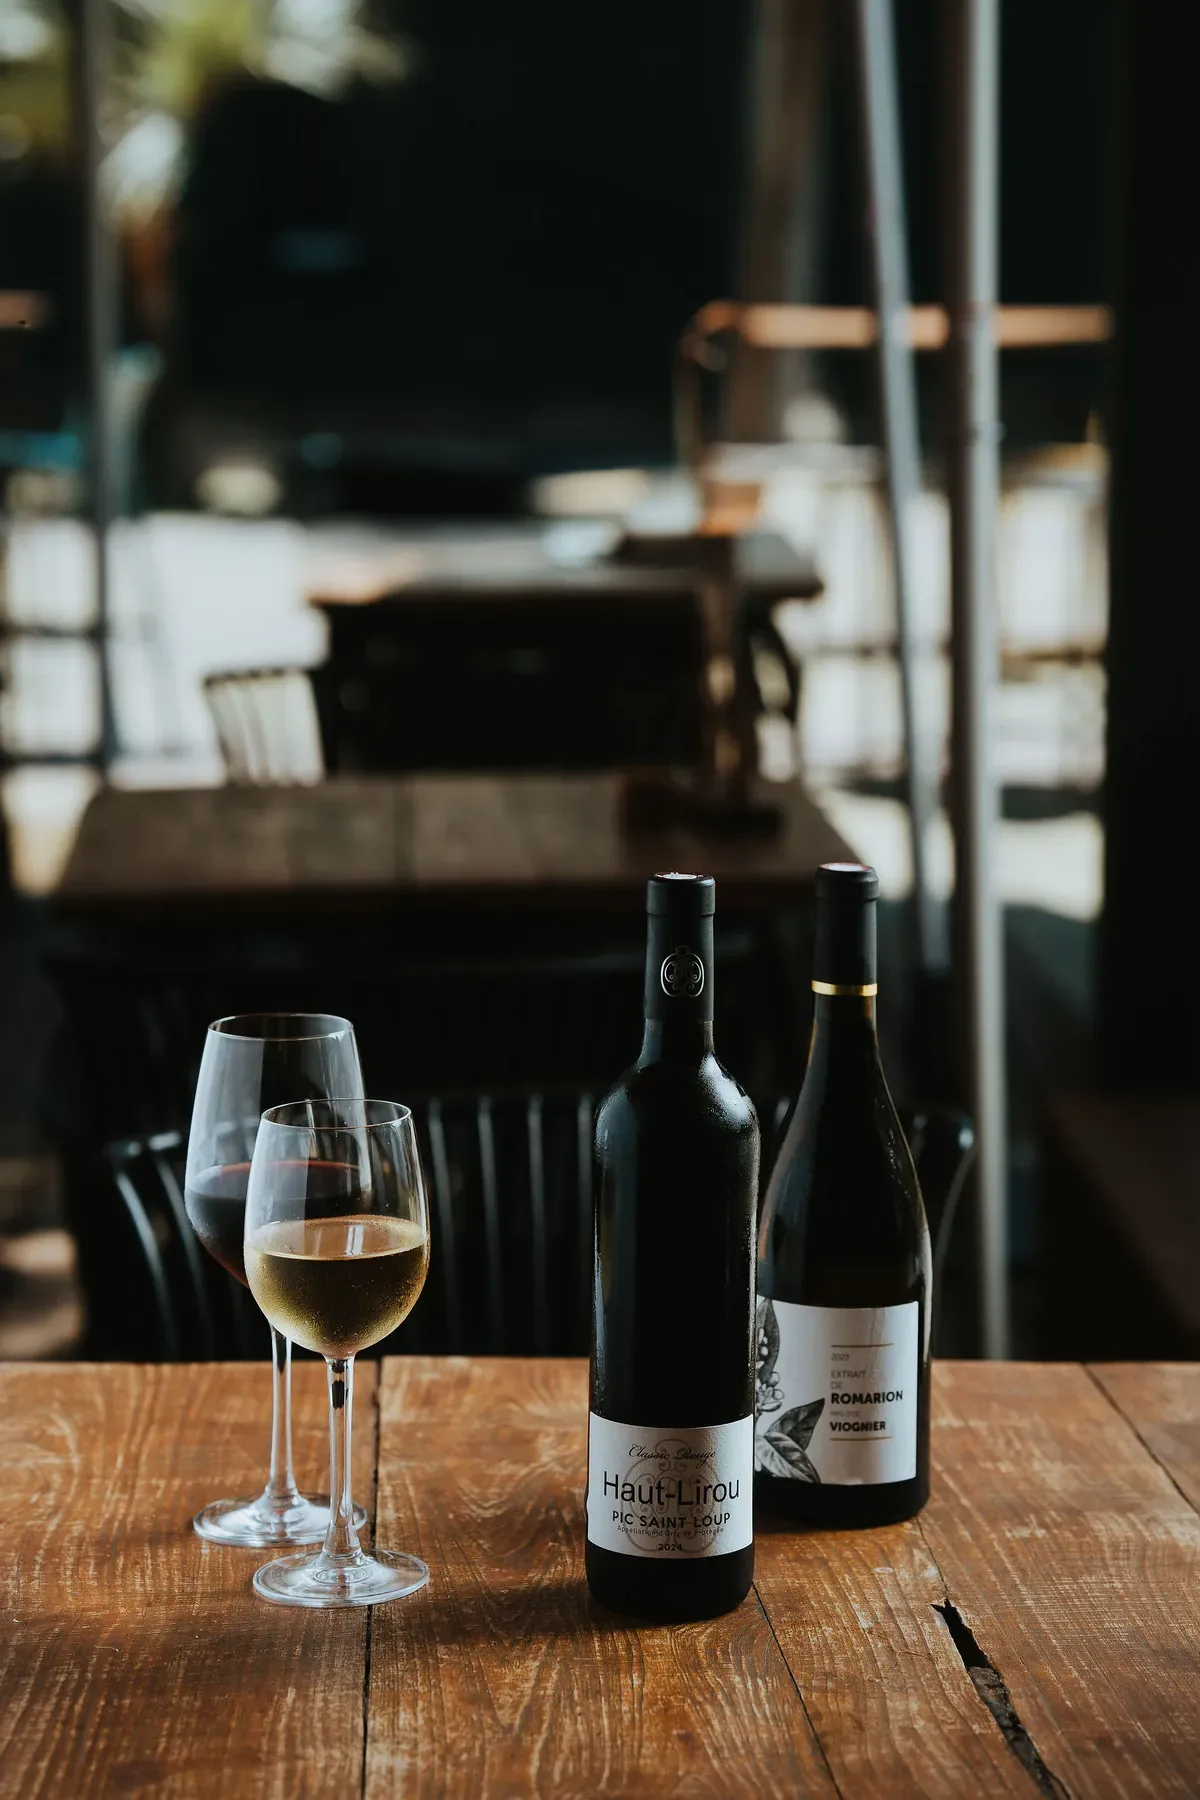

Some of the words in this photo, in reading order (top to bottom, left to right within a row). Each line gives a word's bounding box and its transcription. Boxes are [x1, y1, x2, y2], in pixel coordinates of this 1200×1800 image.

[830, 1370, 867, 1379] EXTRAIT
[831, 1390, 904, 1405] ROMARION
[829, 1421, 886, 1432] VIOGNIER
[628, 1443, 670, 1460] Classic
[673, 1446, 716, 1470] Rouge
[603, 1470, 740, 1506] Haut-Lirou
[612, 1510, 634, 1525] PIC
[639, 1515, 687, 1529] SAINT
[693, 1512, 731, 1528] LOUP
